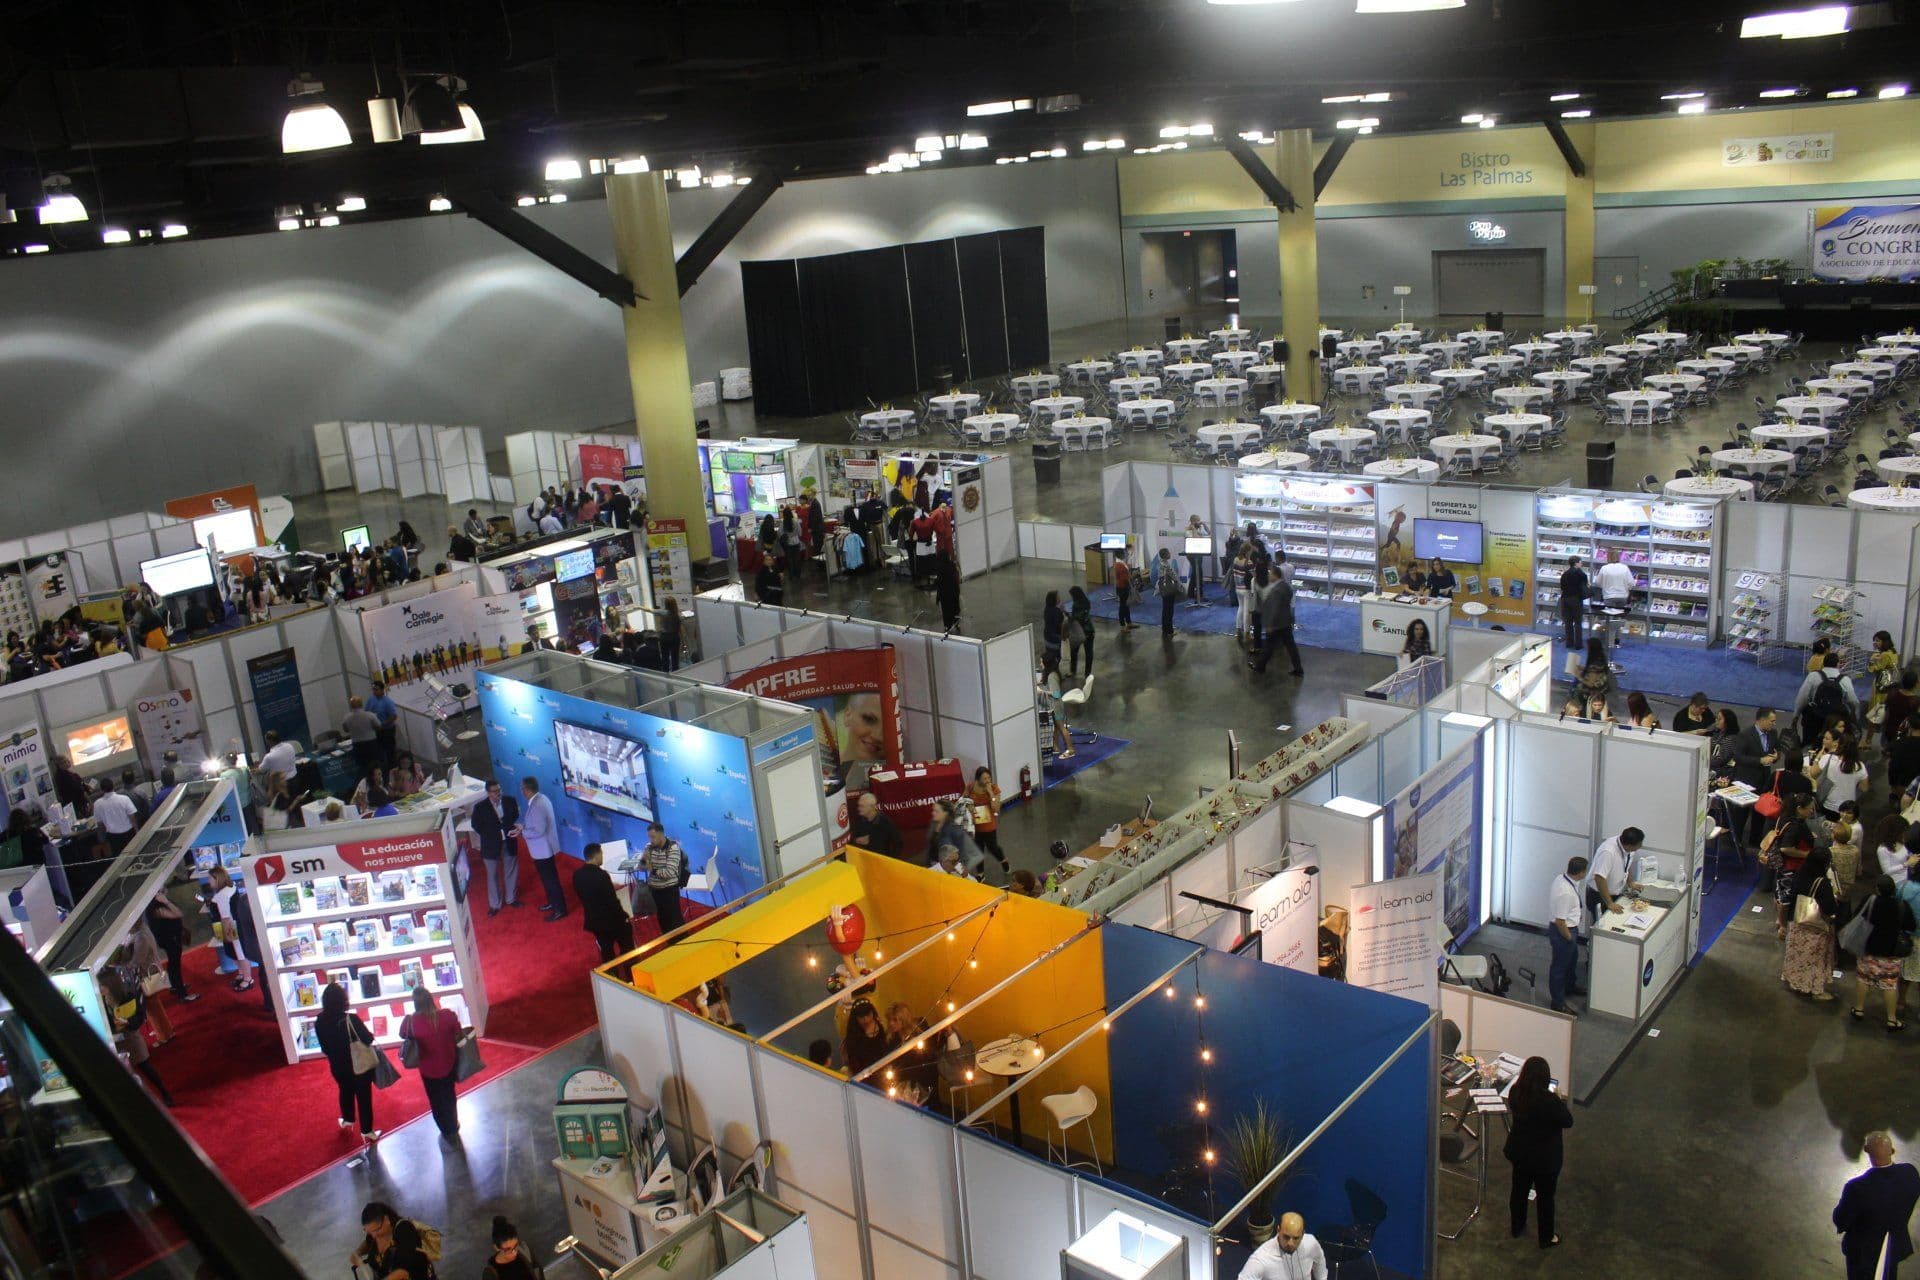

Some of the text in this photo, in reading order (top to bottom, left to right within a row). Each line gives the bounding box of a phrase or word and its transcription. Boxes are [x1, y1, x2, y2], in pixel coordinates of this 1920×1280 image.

[1460, 152, 1511, 169] Bistro
[1440, 168, 1533, 187] Las Palmas
[1431, 501, 1467, 509] DESPIERTA
[1435, 508, 1472, 516] POTENCIAL
[405, 612, 445, 629] Carnegie
[411, 610, 431, 621] Dale
[832, 682, 855, 691] SALUD
[138, 698, 179, 713] Osmo
[3, 742, 38, 765] mimio
[361, 839, 434, 857] La educación
[291, 856, 325, 875] sm
[364, 852, 423, 868] nos mueve
[1380, 890, 1433, 911] learn aid
[1256, 896, 1291, 931] learn
